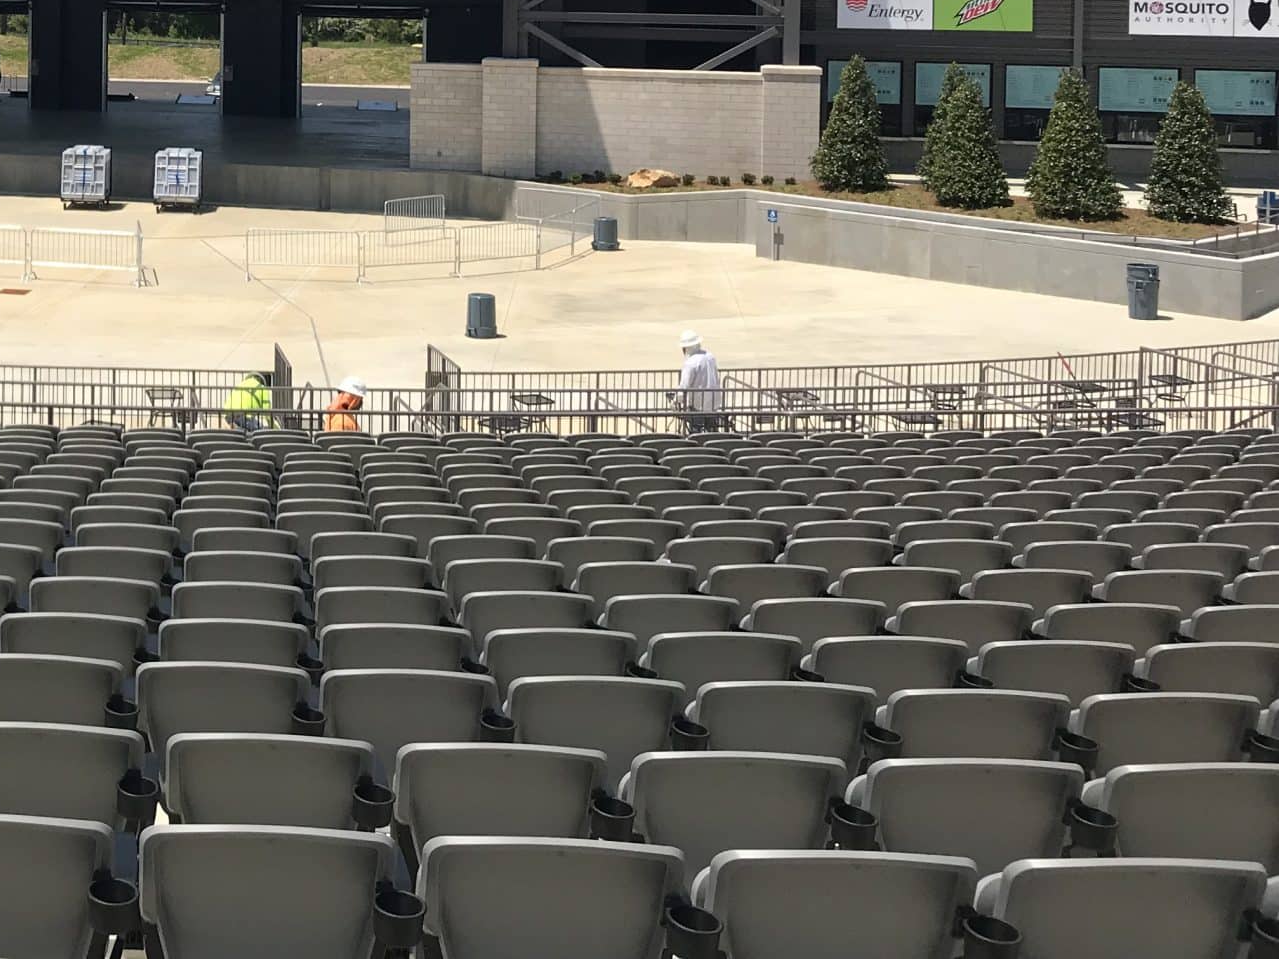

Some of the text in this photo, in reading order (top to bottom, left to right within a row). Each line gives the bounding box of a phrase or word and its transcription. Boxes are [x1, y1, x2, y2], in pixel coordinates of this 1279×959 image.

[868, 4, 923, 21] Entergy
[1134, 1, 1230, 15] MOSQUITO
[1134, 16, 1228, 24] AUTHORITY
